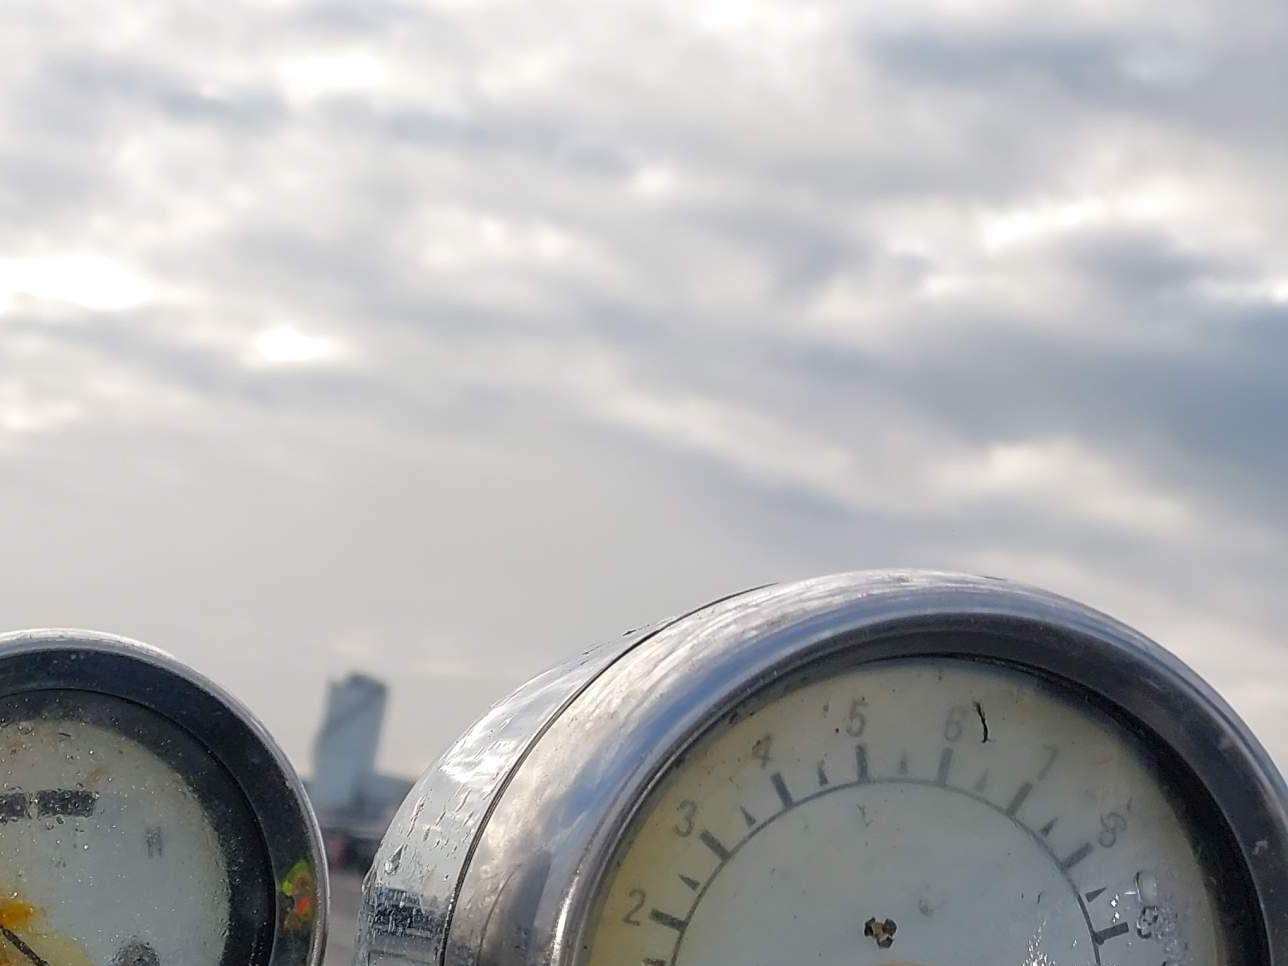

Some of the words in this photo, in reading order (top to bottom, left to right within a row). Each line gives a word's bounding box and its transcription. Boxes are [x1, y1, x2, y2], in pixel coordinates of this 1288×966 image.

[845, 700, 868, 737] 5
[751, 734, 774, 768] 4
[674, 800, 697, 838] 3
[622, 888, 648, 927] 2
